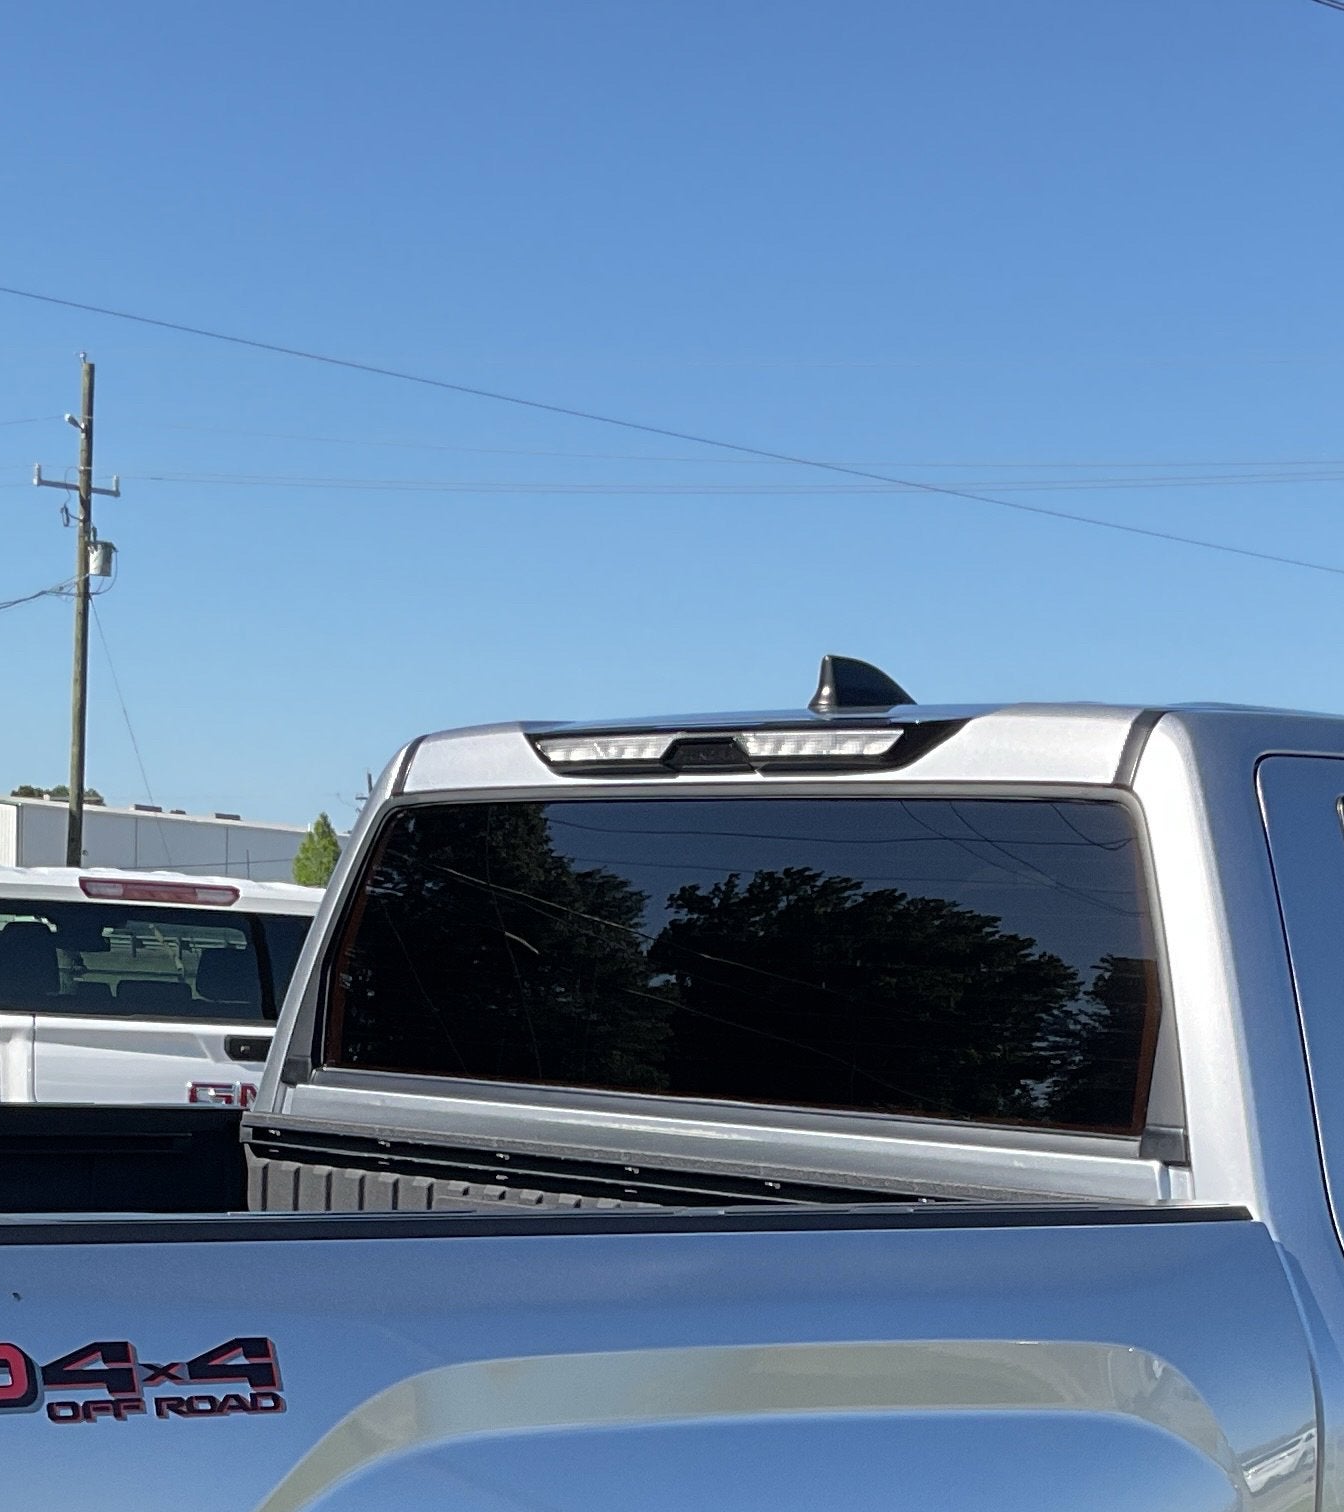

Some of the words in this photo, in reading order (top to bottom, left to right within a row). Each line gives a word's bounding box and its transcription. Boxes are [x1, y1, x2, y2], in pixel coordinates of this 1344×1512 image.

[42, 1337, 281, 1397] 4x4
[46, 1399, 145, 1424] OFF
[155, 1392, 285, 1418] ROAD
